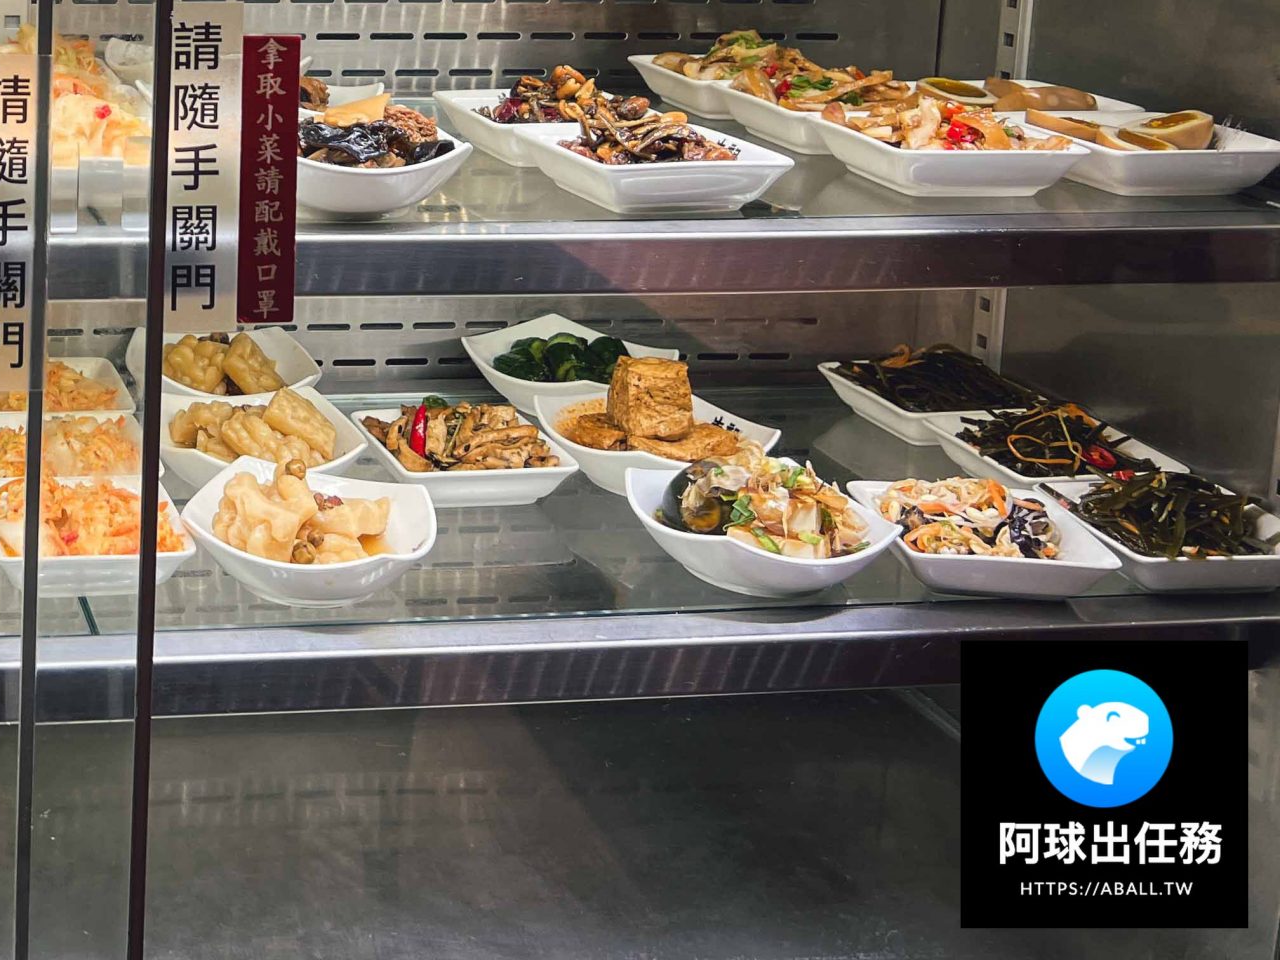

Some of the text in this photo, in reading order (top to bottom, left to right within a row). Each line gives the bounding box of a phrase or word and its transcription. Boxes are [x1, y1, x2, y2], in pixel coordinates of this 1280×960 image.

[171, 21, 222, 311] 請隨手關門
[252, 38, 287, 320] 拿取小菜請配戴口罩
